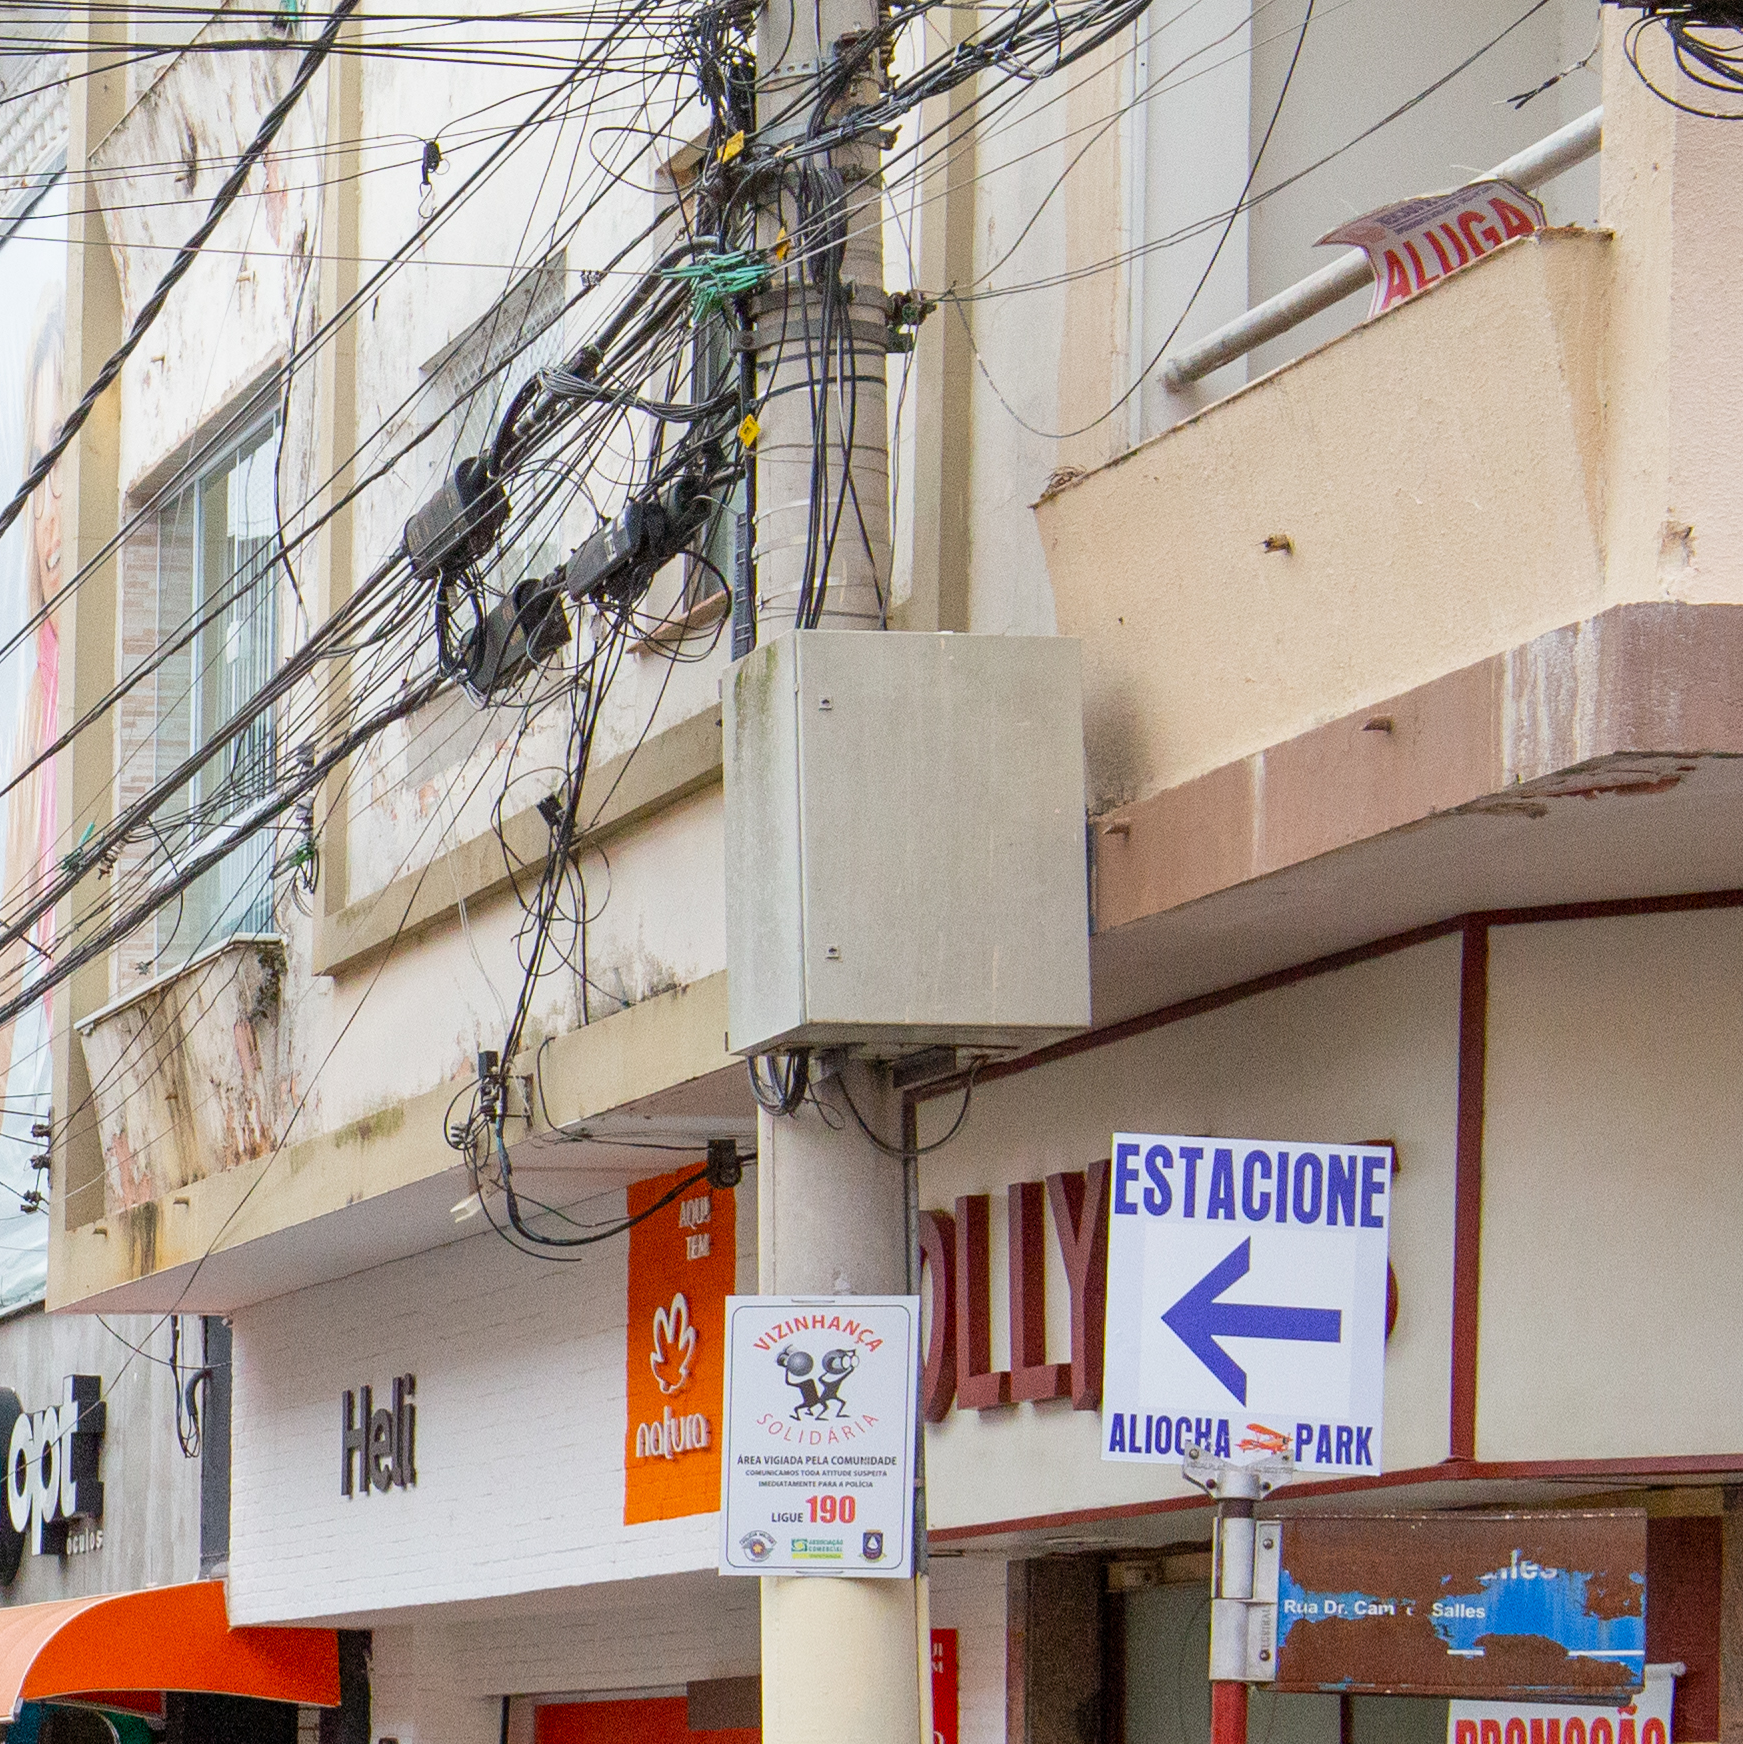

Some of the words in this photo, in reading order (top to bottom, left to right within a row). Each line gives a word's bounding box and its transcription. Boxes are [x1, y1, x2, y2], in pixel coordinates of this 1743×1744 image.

[1380, 197, 1535, 311] ALUGA
[1114, 1142, 1386, 1228] ESTACIONE
[753, 1314, 884, 1352] VIZINHANÇA
[341, 1372, 417, 1500] Heli
[635, 1405, 710, 1460] natura
[756, 1412, 880, 1446] SOLIDÁRIA
[1109, 1412, 1232, 1459] ALIOCHA
[1295, 1423, 1373, 1466] PARK
[737, 1454, 762, 1465] ÁREA
[764, 1455, 803, 1465] VIGIADA
[805, 1455, 829, 1465] PELA
[830, 1455, 898, 1466] COMUNIDADE
[745, 1469, 799, 1477] COMUNICAMOS
[801, 1469, 820, 1477] TODA
[822, 1469, 851, 1477] ATITUDE
[853, 1469, 888, 1477] SUSPEITA
[758, 1480, 816, 1488] IMEDIATAMENTE
[818, 1480, 837, 1488] PARA
[845, 1479, 873, 1488] POLÍCIA
[771, 1511, 803, 1523] LIGUE
[805, 1495, 856, 1524] 190
[66, 1527, 104, 1556] óculos
[1284, 1600, 1319, 1614] Rua
[1324, 1600, 1349, 1615] Dr.
[1432, 1602, 1486, 1619] Salles
